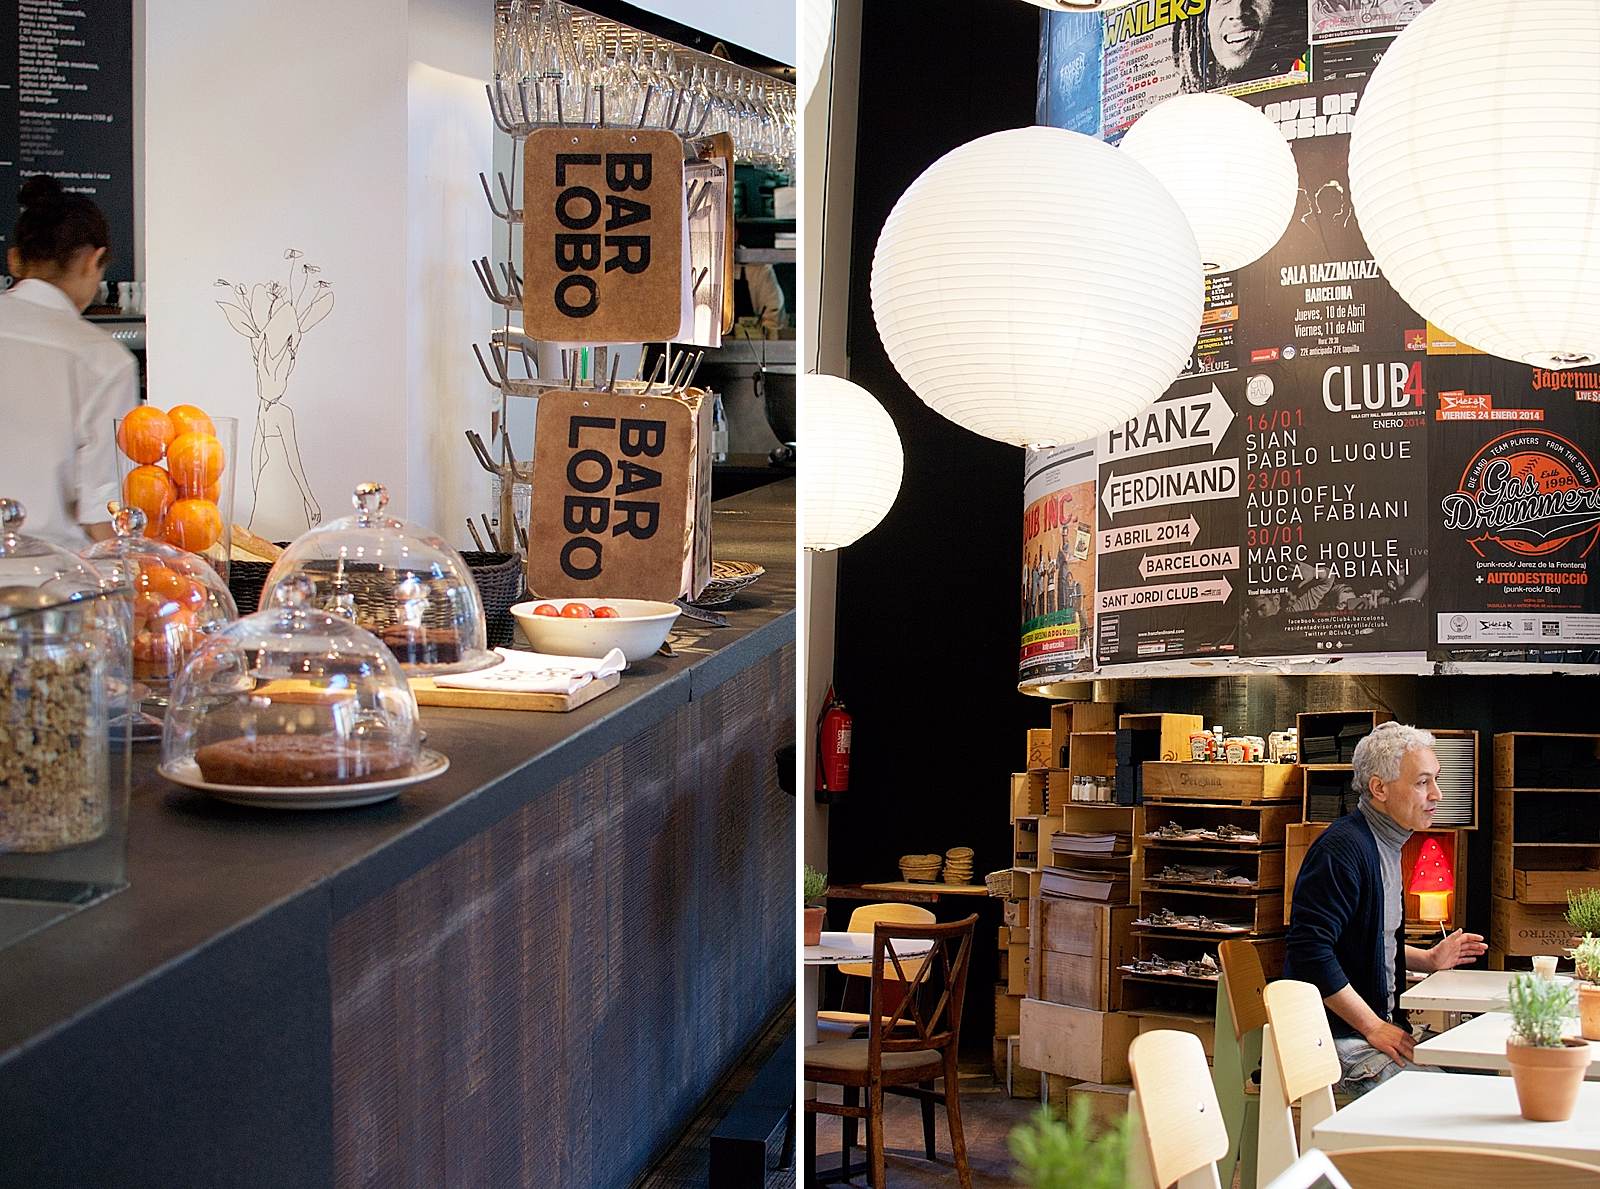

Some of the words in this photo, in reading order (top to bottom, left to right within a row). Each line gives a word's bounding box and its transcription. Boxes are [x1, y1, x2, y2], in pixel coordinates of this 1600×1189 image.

[1127, 77, 1159, 94] APOLO
[1256, 97, 1317, 122] OVE
[1322, 92, 1358, 116] OF
[604, 153, 653, 275] BAR
[554, 153, 602, 319] LOBO
[1280, 265, 1308, 286] SALA
[1309, 260, 1379, 284] RAZZMATAZZ
[1305, 285, 1353, 304] BARCELONA
[1294, 309, 1324, 322] Jueves,
[1325, 305, 1336, 319] 10
[1336, 305, 1347, 318] de
[1347, 303, 1366, 318] Abril
[1294, 324, 1325, 338] Viernes,
[1325, 321, 1335, 335] 11
[1335, 321, 1346, 334] de
[1346, 319, 1366, 334] Abril
[1247, 409, 1303, 432] 16/01
[1442, 411, 1476, 421] VIERNES
[1479, 411, 1489, 420] 24
[1490, 411, 1518, 420] ENERO
[1519, 411, 1541, 420] 2014
[1109, 402, 1212, 454] FRANZ
[1246, 429, 1298, 452] SIAN
[1490, 442, 1510, 456] TEAM
[1510, 437, 1540, 447] PLAYERS
[1246, 447, 1318, 471] PABLO
[1330, 440, 1412, 463] LUQUE
[1472, 458, 1488, 476] HARD
[1546, 440, 1563, 454] FROM
[1564, 450, 1578, 463] THE
[1575, 461, 1591, 485] SOUTH
[612, 418, 667, 540] BAR
[1110, 466, 1237, 508] FERDINAND
[1247, 469, 1303, 491] 23/01
[1467, 477, 1478, 489] DIE
[1545, 475, 1574, 489] 1998
[560, 415, 617, 580] LOBO
[1246, 484, 1356, 509] AUDIOFLY
[1247, 506, 1303, 528] LUCA
[1313, 500, 1409, 522] FABIANI
[1104, 535, 1112, 549] 5
[1114, 528, 1154, 548] ABRIL
[1156, 523, 1190, 541] 2014
[1247, 526, 1303, 547] 30/01
[1146, 551, 1233, 573] BARCELONA
[1247, 544, 1309, 565] MARC
[1319, 540, 1399, 561] HOULE
[1408, 546, 1430, 557] live
[1247, 564, 1304, 585] LUCA
[1315, 558, 1411, 580] FABIANI
[1475, 560, 1517, 570] (punk-rock/
[1517, 560, 1538, 569] Jerez
[1538, 560, 1548, 569] de
[1556, 561, 1587, 570] Frontera)
[1486, 570, 1589, 585] AUTODESTRUCCIÓ
[1102, 594, 1129, 609] SANT
[1130, 590, 1163, 605] JORDI
[1166, 586, 1199, 601] CLUB
[1503, 585, 1544, 594] (punk-rock/
